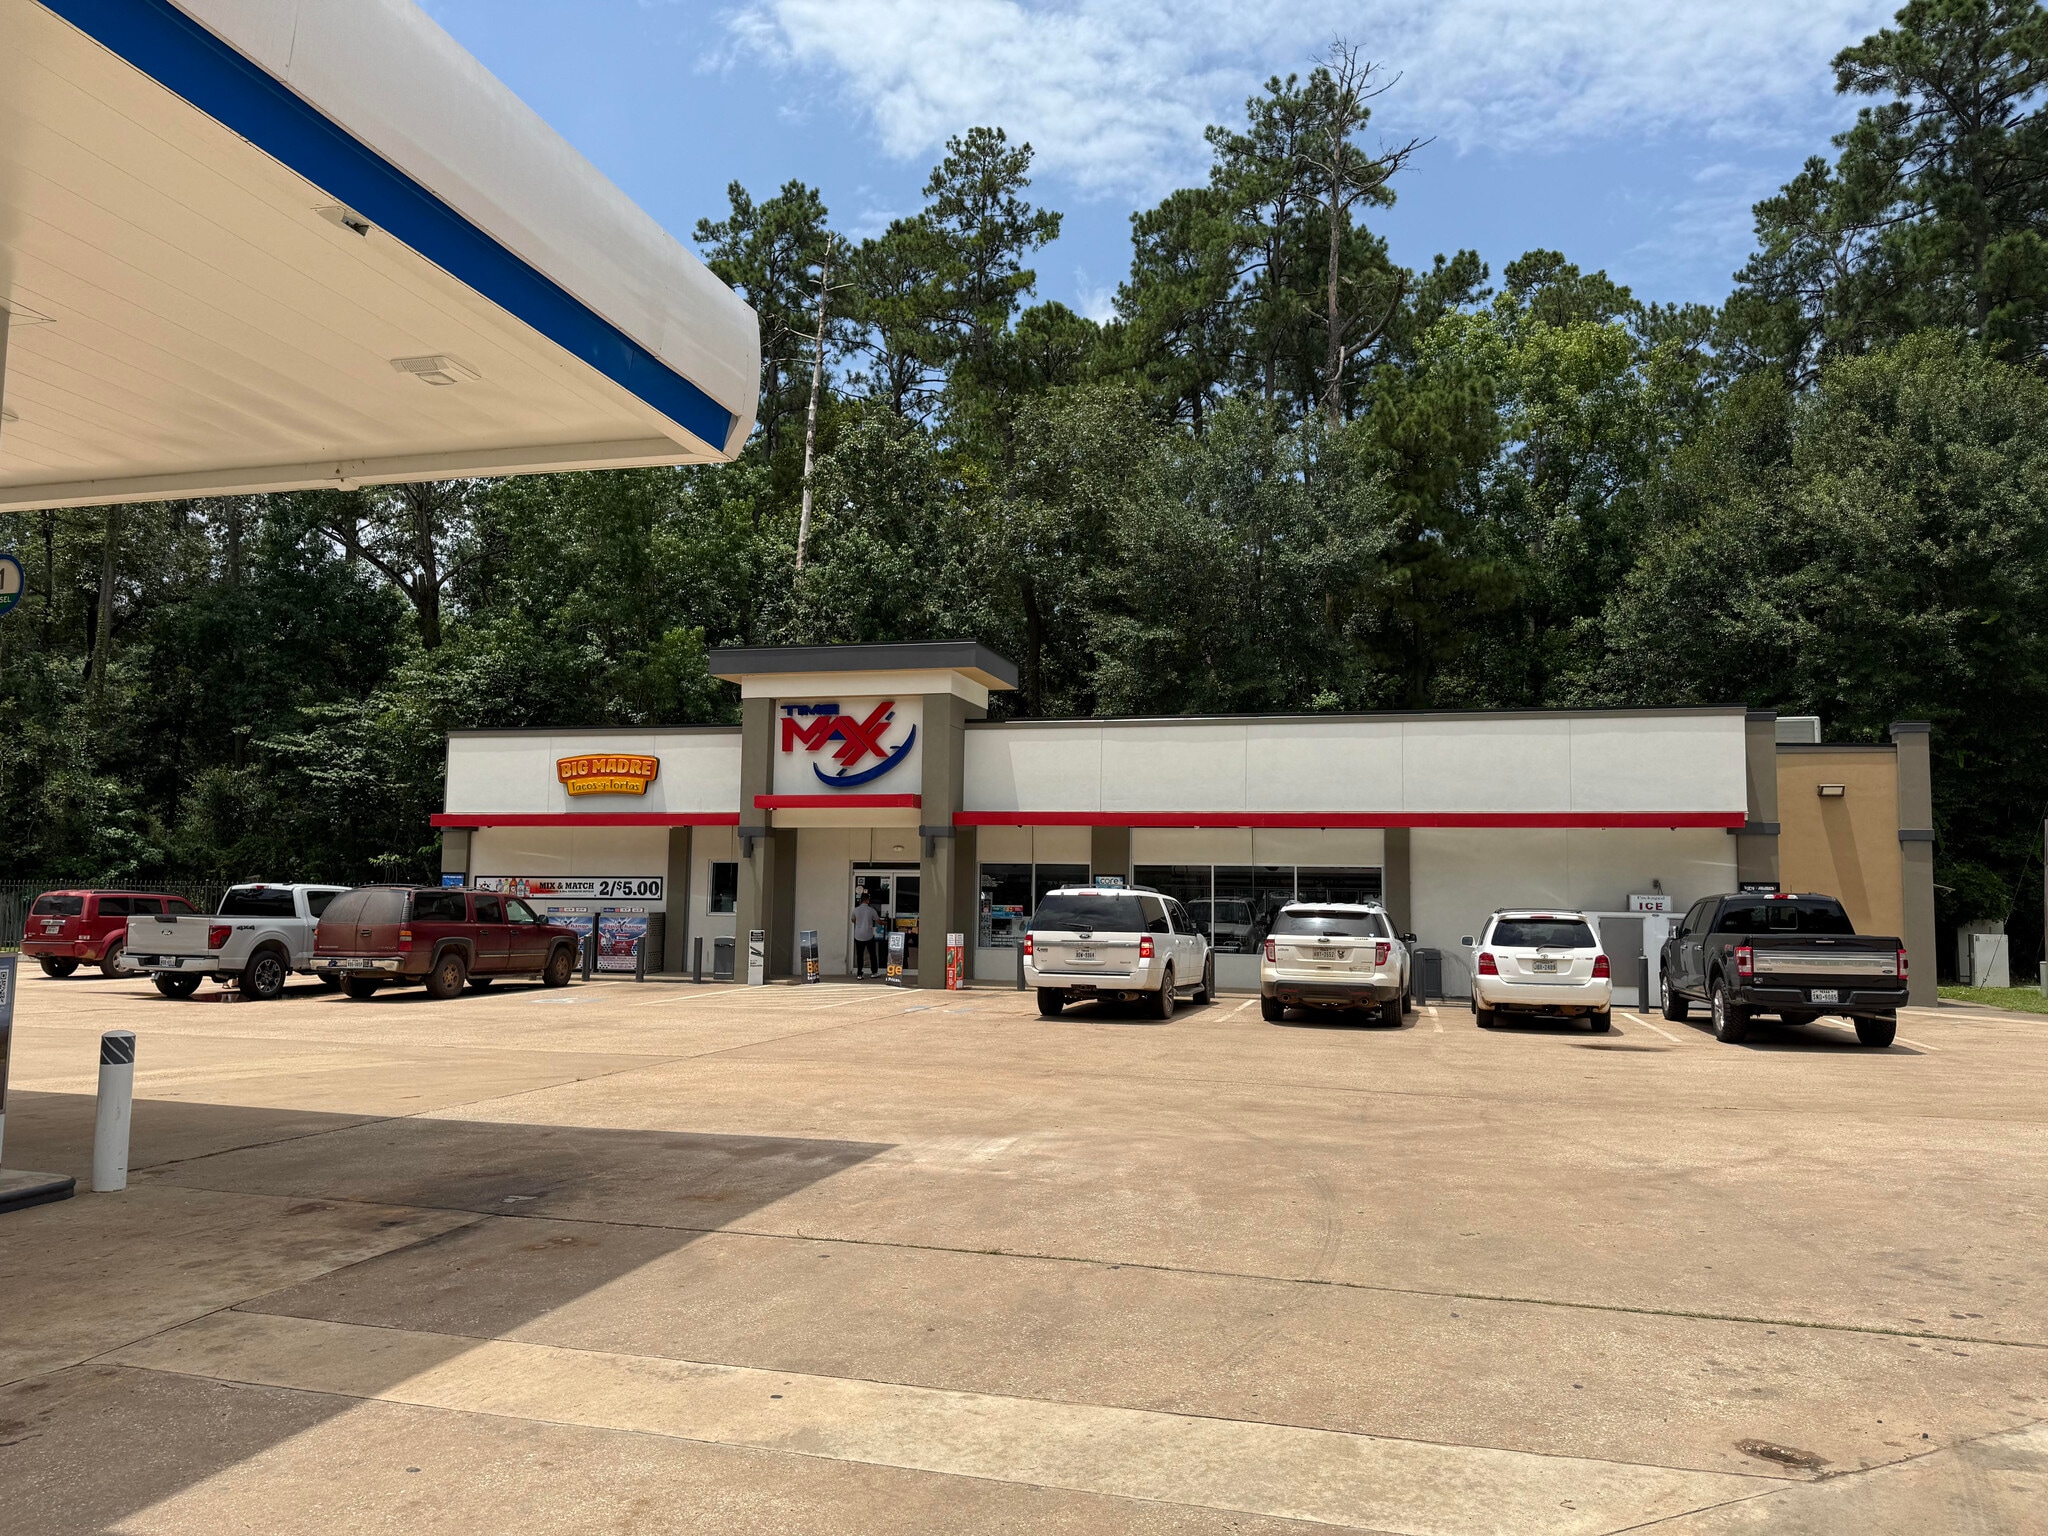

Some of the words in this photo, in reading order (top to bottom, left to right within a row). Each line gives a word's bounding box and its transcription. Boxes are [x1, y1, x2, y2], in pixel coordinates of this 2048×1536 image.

[780, 703, 840, 717] TIME
[780, 701, 896, 767] MAX
[560, 760, 589, 778] BIG
[592, 758, 653, 775] MADRE
[599, 880, 660, 897] 2/$5.00
[1639, 902, 1664, 911] ICE
